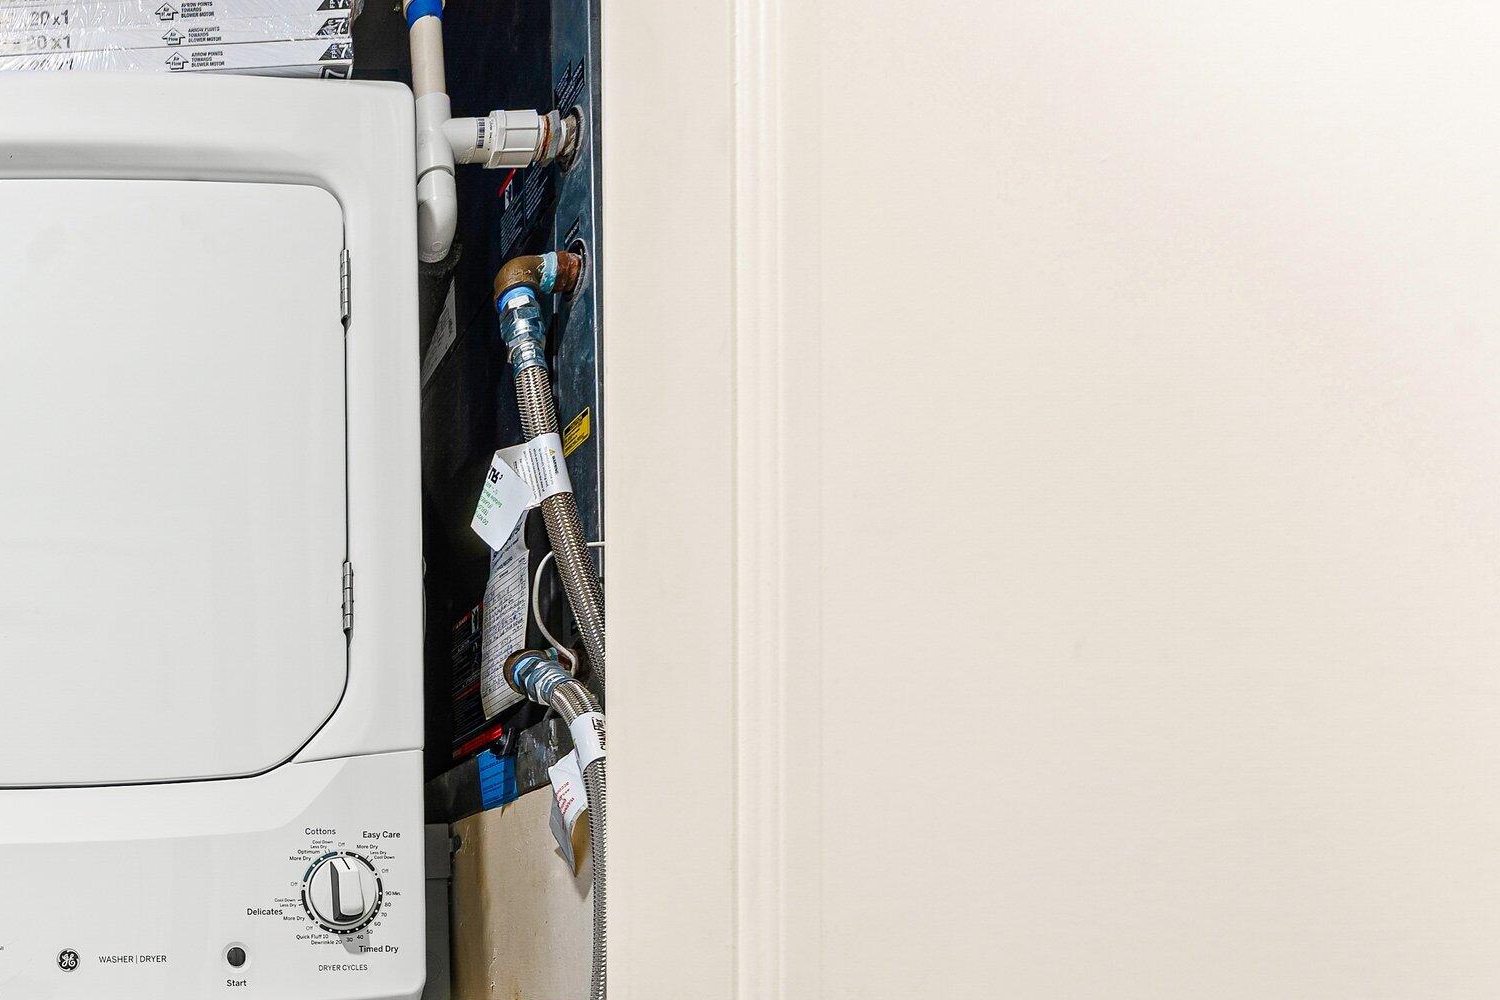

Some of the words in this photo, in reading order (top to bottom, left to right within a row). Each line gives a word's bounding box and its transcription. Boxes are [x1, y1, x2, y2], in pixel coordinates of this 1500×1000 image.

[305, 828, 336, 836] Cottons
[362, 831, 381, 840] Easy
[382, 831, 401, 839] Care
[246, 908, 283, 916] Delicates
[359, 945, 384, 953] Timed
[385, 945, 399, 954] Dry
[98, 955, 134, 964] WASHER
[139, 955, 167, 964] DRYER
[226, 979, 247, 987] Start
